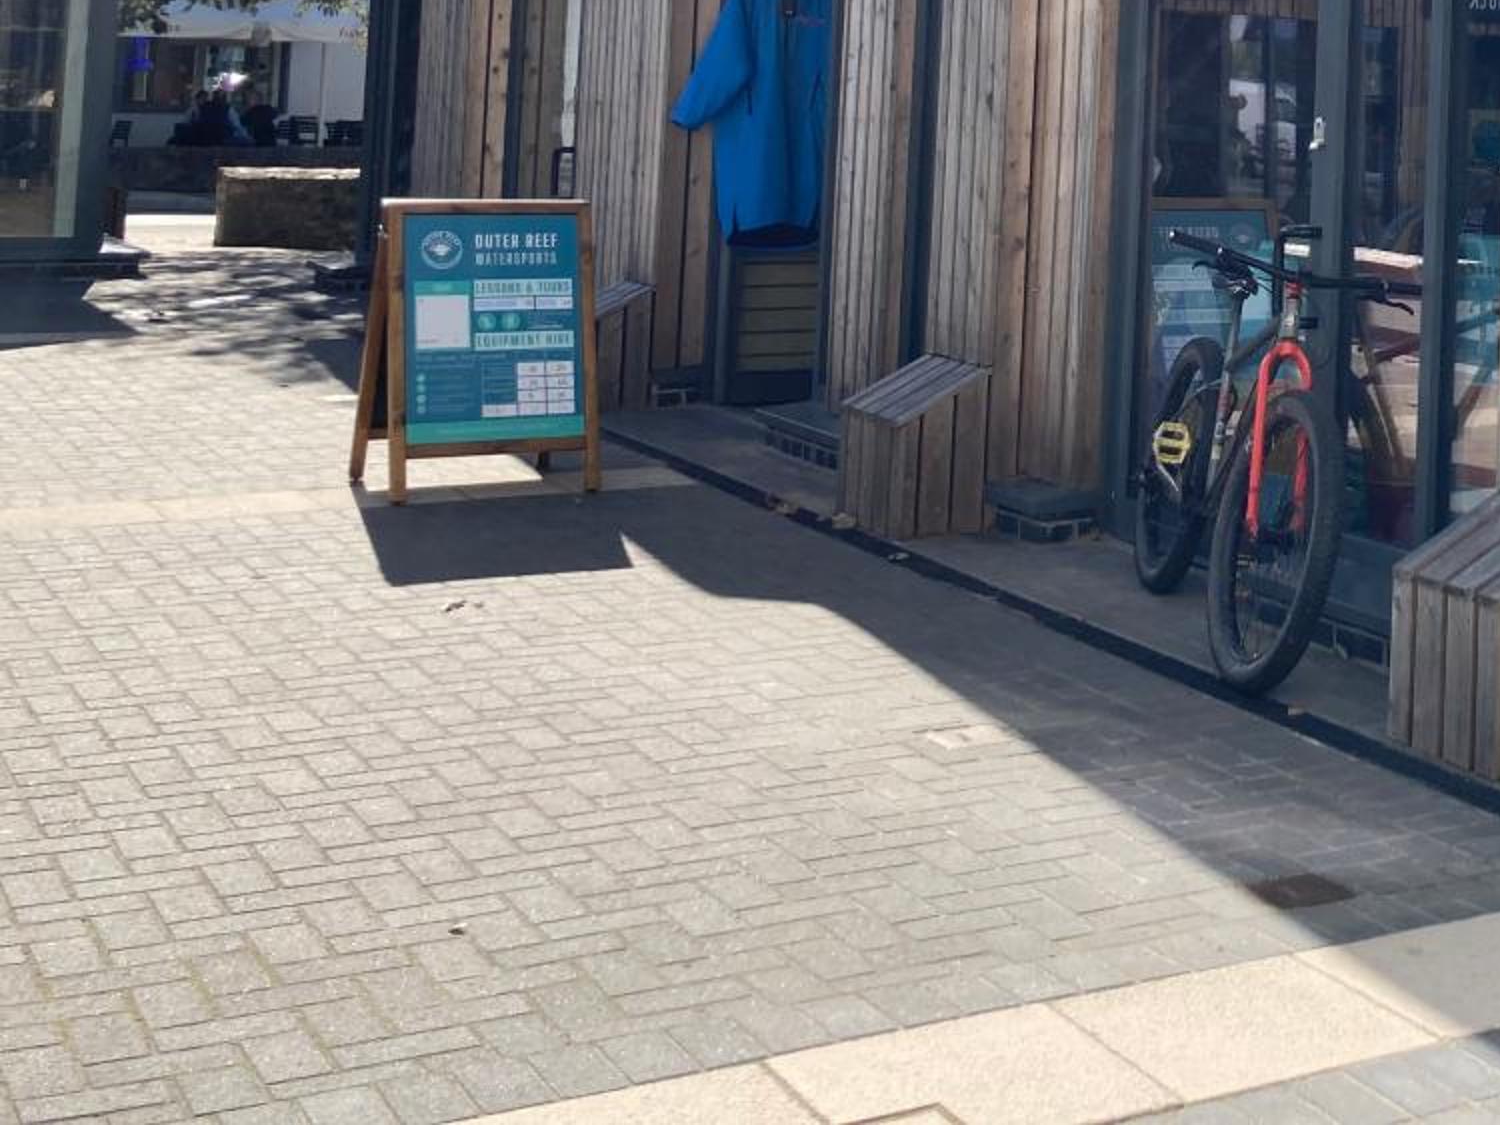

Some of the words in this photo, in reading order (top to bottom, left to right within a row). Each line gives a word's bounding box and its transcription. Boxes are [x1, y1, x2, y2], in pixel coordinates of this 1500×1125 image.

[475, 233, 520, 249] OUTER
[525, 232, 559, 248] REEF
[475, 251, 558, 266] WATERSPORTS
[477, 333, 541, 348] EQUIPMENT
